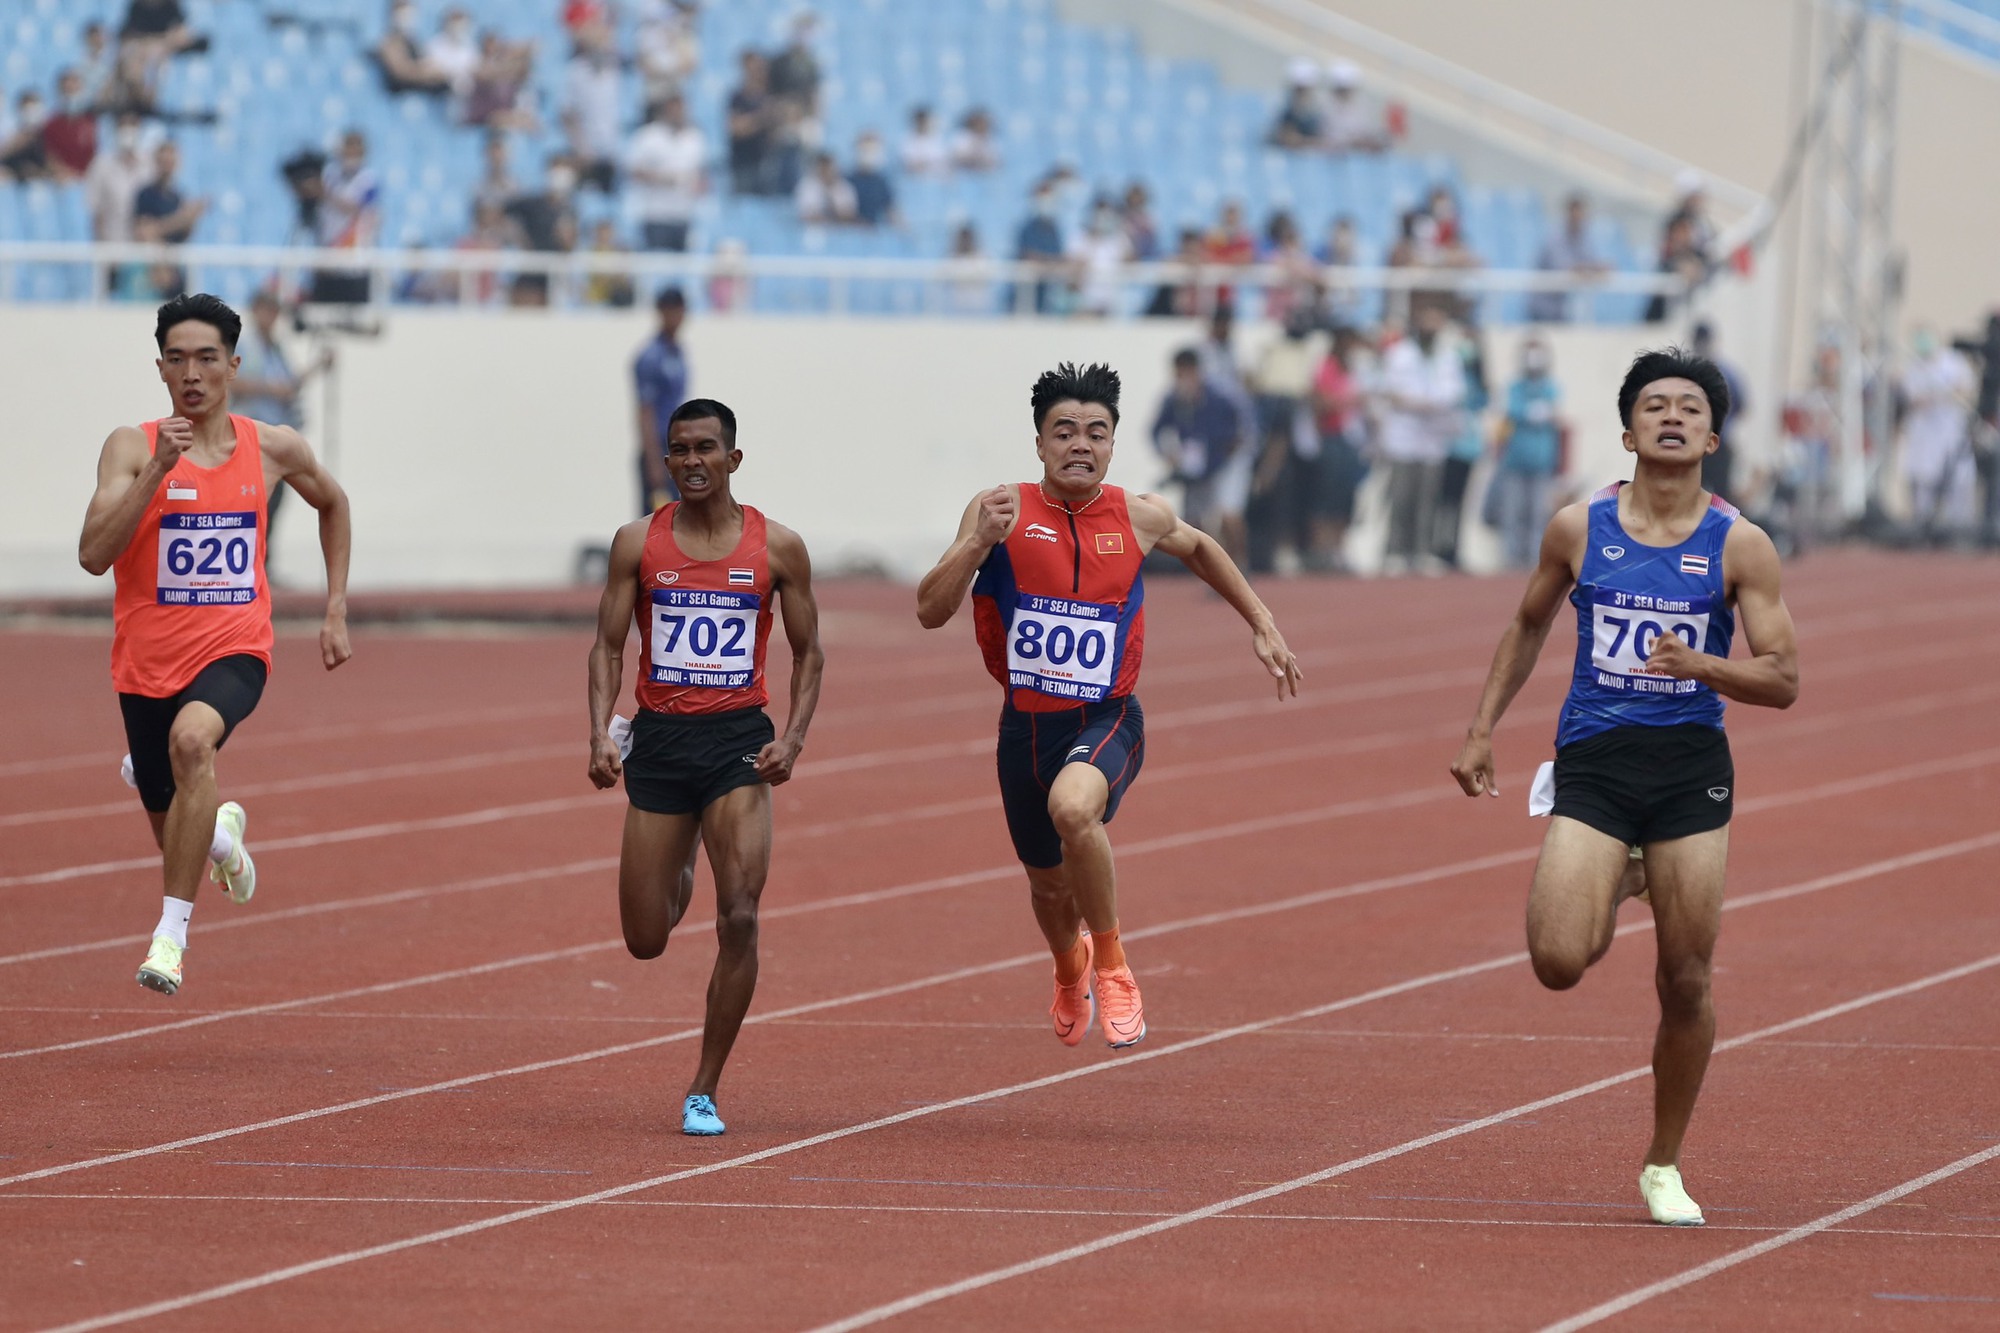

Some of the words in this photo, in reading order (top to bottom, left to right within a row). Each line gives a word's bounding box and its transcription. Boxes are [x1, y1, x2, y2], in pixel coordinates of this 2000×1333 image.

[197, 515, 214, 528] SEA
[215, 515, 243, 527] Games
[167, 537, 249, 576] 620
[165, 590, 190, 603] HANOI
[197, 591, 232, 603] VIETNAM
[233, 590, 251, 602] 2022
[688, 592, 707, 605] SEA
[709, 593, 741, 607] Games
[1633, 595, 1654, 609] SEA
[1656, 597, 1691, 612] Games
[1049, 600, 1068, 614] SEA
[1070, 603, 1101, 618] Games
[660, 613, 746, 657] 702
[1014, 619, 1106, 669] 800
[684, 661, 722, 670] THAILAND
[1039, 668, 1073, 678] VIETNAM
[657, 668, 682, 683] HANOI
[689, 672, 727, 686] VIETNAM
[1009, 672, 1035, 688] HANOI
[1041, 679, 1079, 698] VIETNAM
[1080, 685, 1101, 699] 2022
[1598, 672, 1625, 690] HANOI
[1633, 678, 1674, 694] VIETNAM
[1675, 679, 1697, 694] 2022
